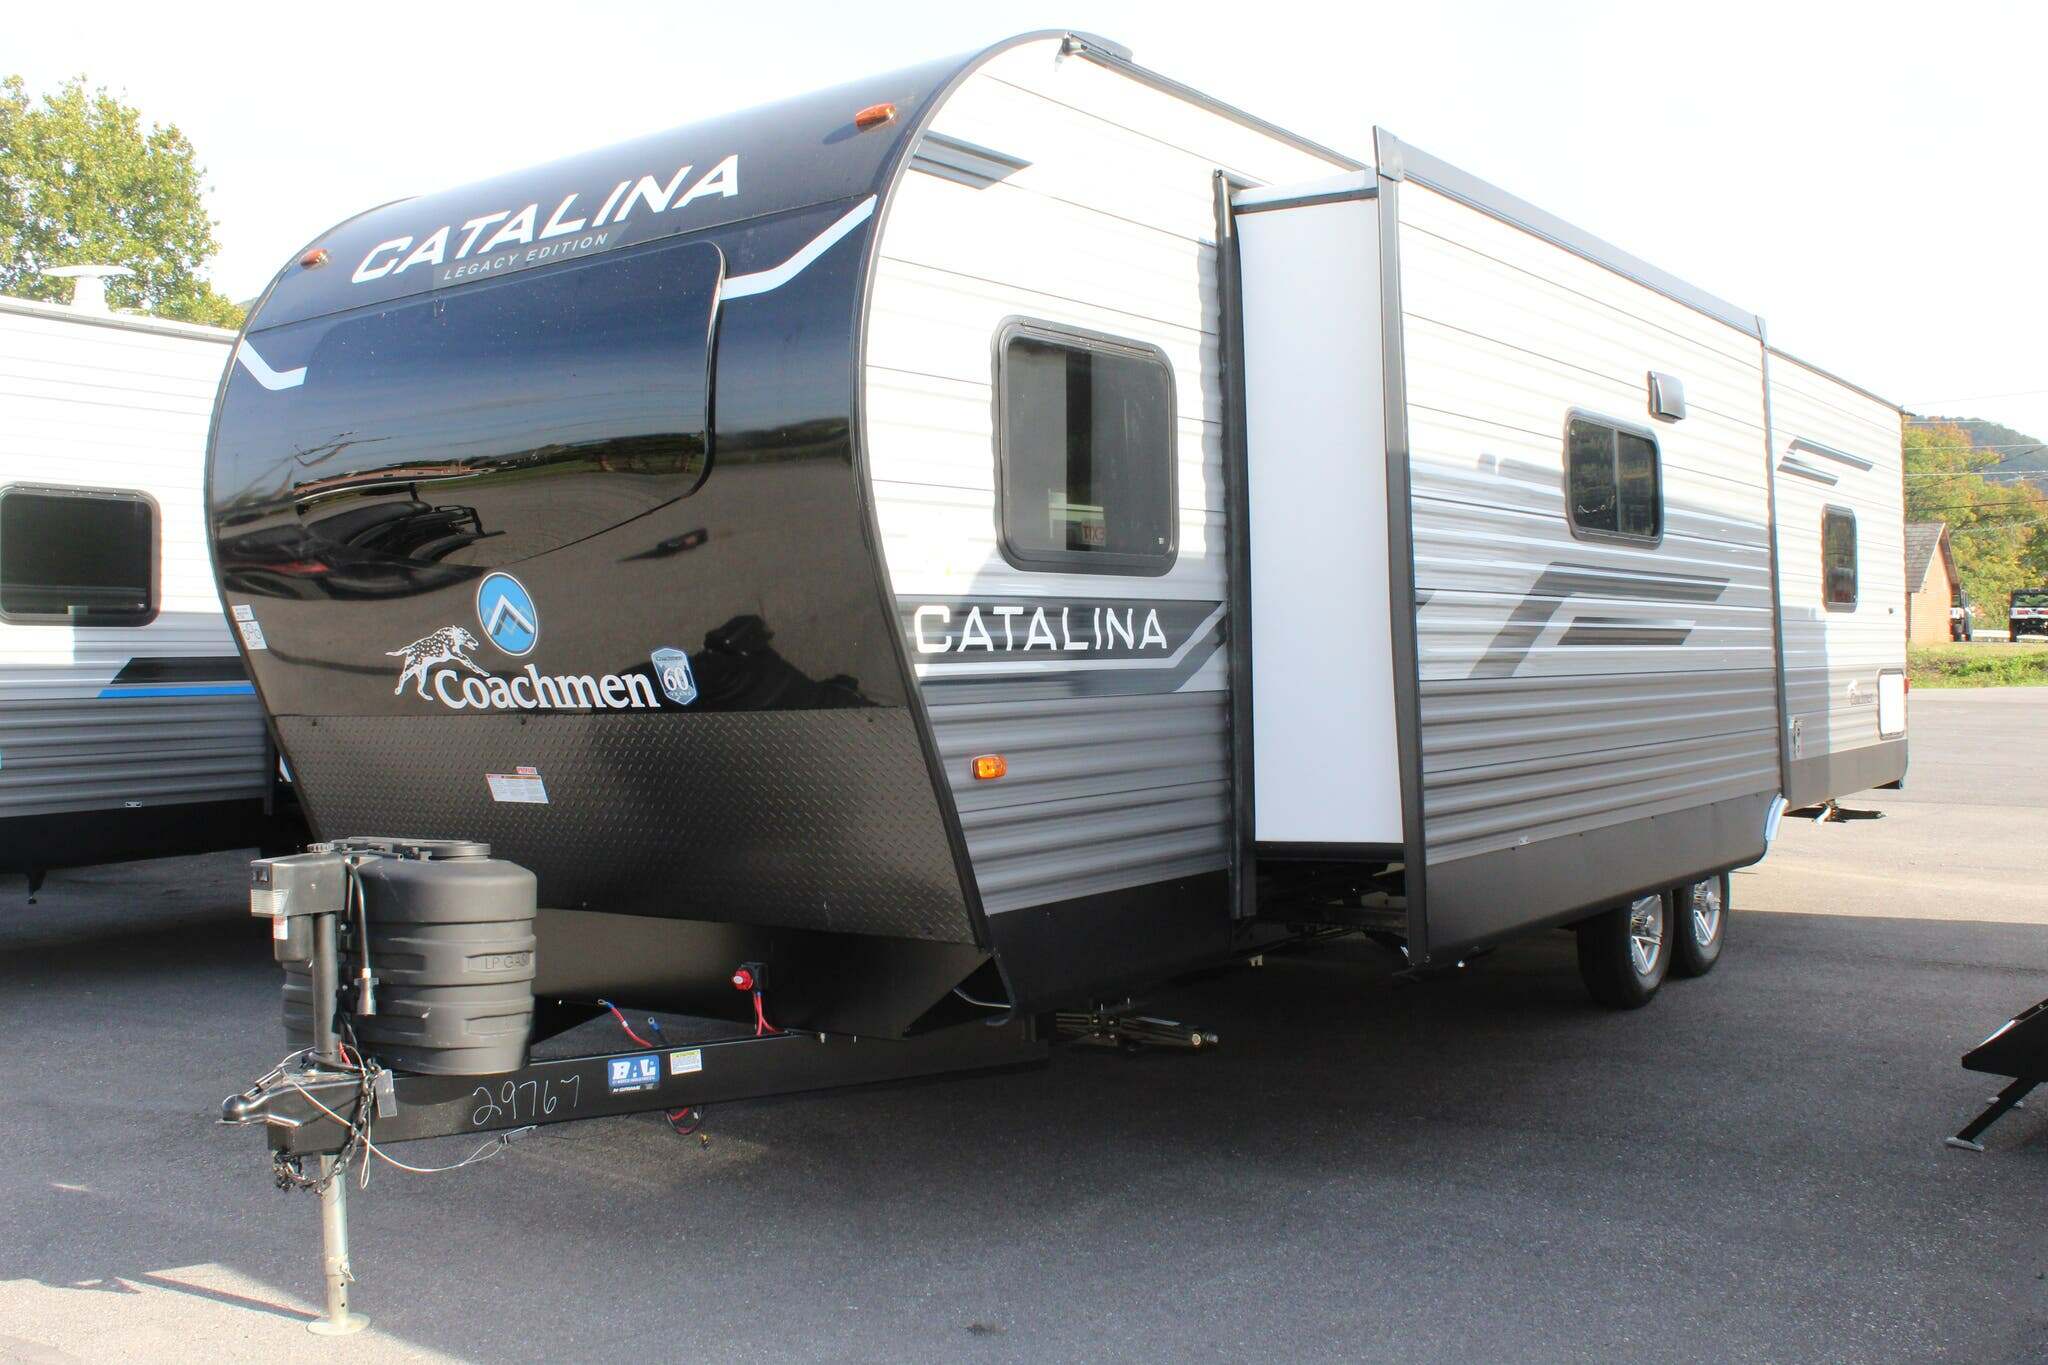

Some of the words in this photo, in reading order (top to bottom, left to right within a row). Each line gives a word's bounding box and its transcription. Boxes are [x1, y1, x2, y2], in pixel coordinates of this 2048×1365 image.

[352, 154, 739, 284] CATALINA
[443, 252, 516, 281] LEGACY
[526, 233, 608, 263] EDITION
[914, 605, 1167, 653] CATALINA
[434, 664, 661, 709] Coachmen
[663, 667, 689, 691] 60
[472, 1074, 580, 1125] 29767
